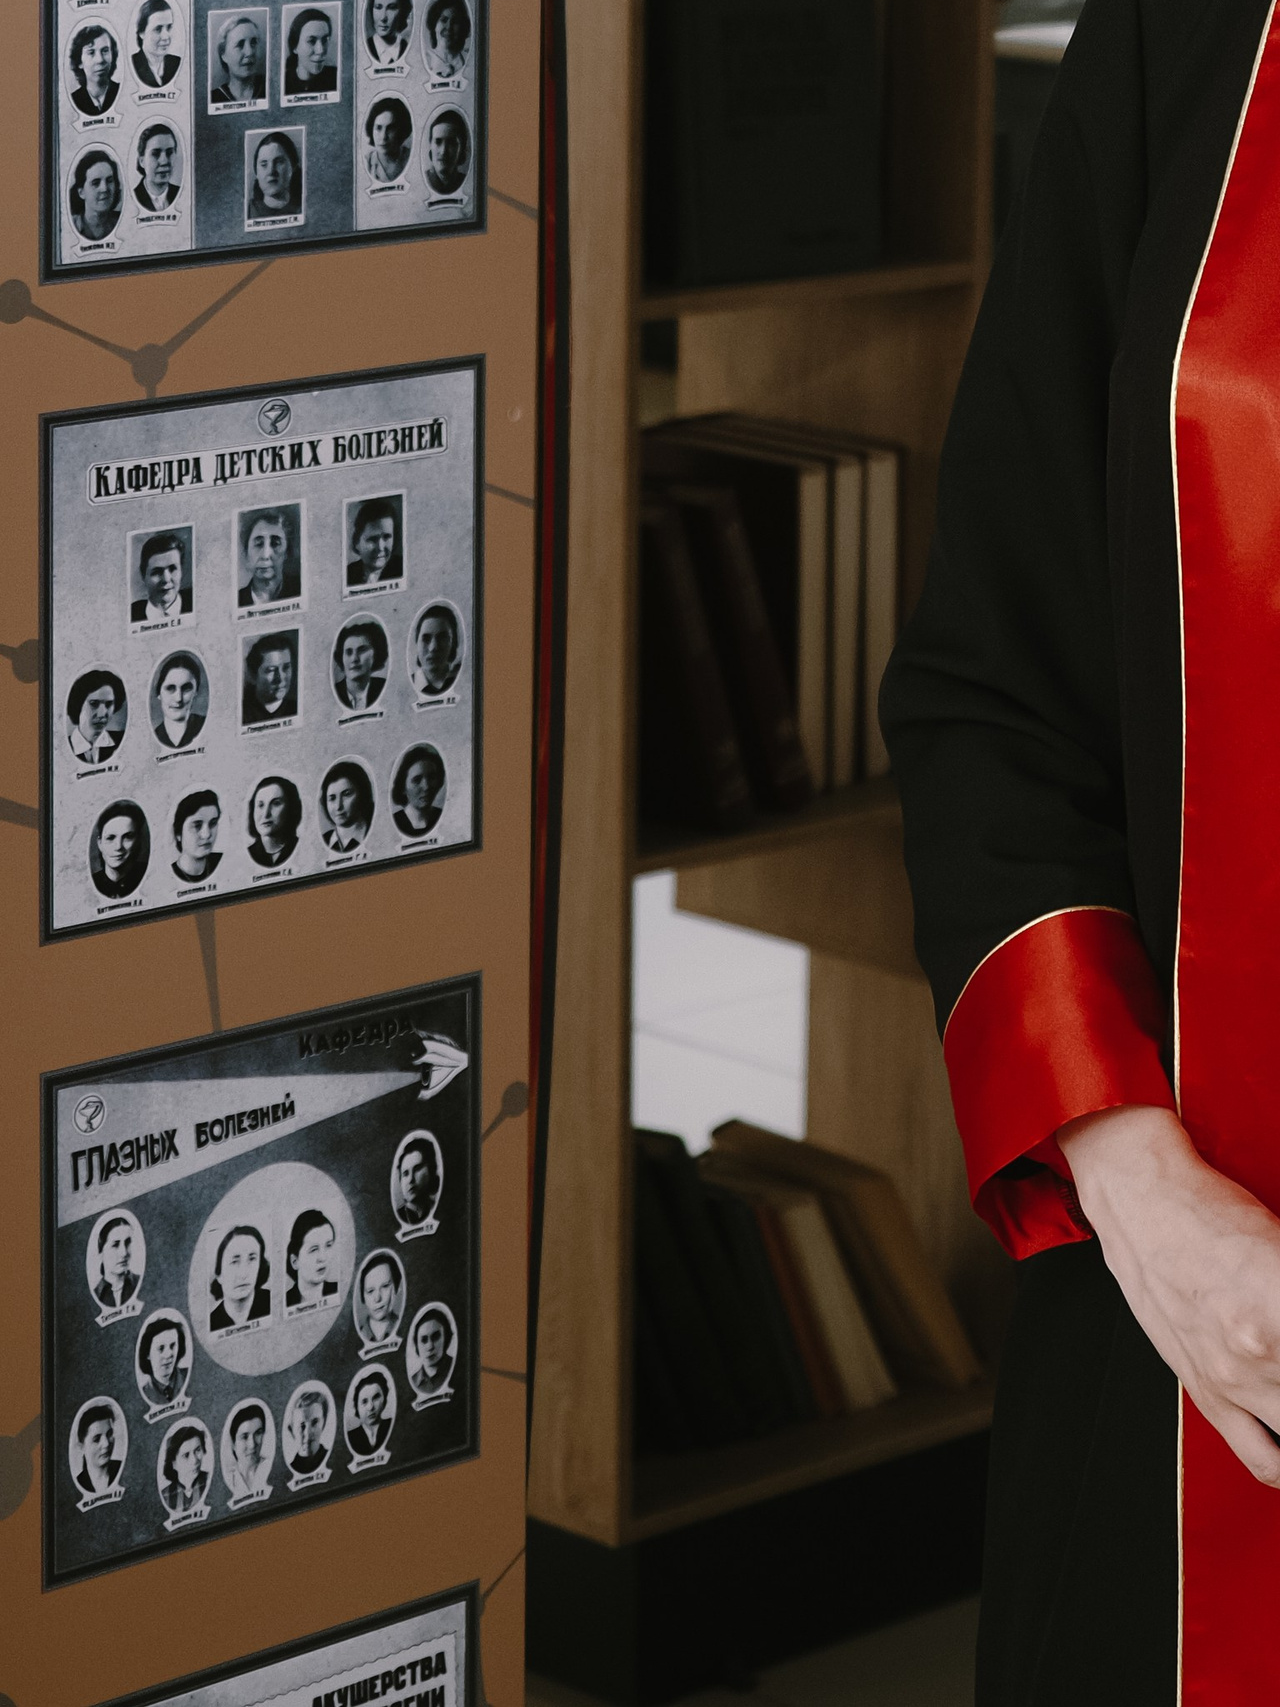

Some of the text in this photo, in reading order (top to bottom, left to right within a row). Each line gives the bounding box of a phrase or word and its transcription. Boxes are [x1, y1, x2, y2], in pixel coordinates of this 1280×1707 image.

[93, 417, 445, 498] КАФЕДРА ДЕТСКИХ БОЛЕЗНЕЙ
[300, 1017, 417, 1061] КАФЕДРА
[70, 1092, 296, 1193] ГЛАЗНЫХ БОЛЕЗНЕЙ
